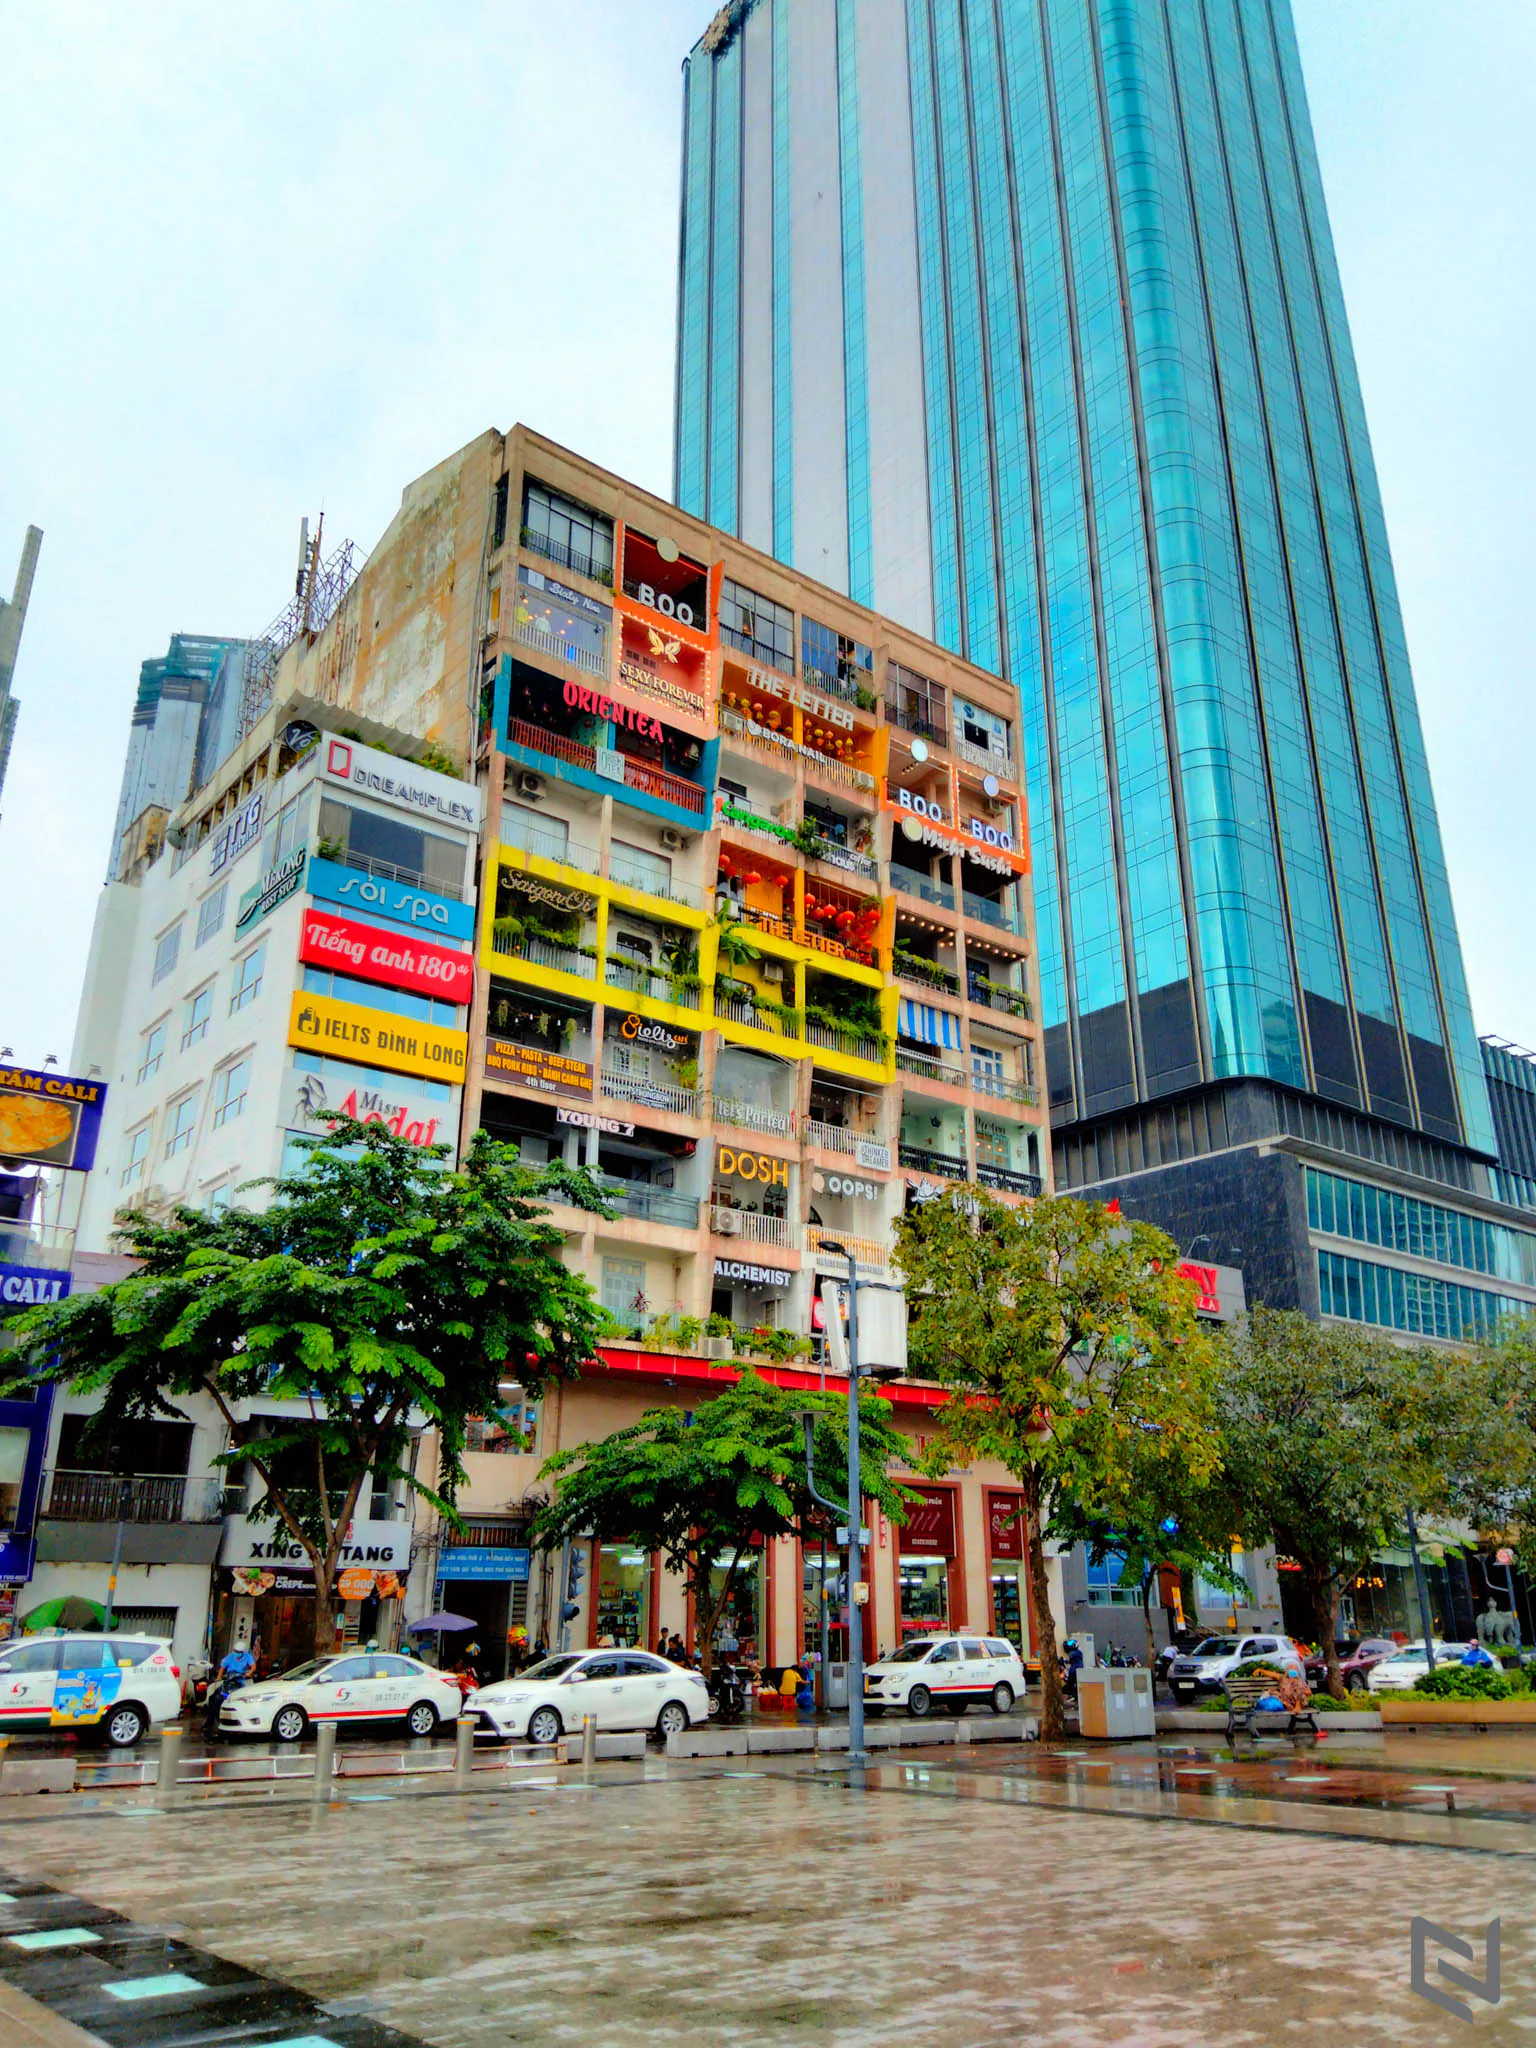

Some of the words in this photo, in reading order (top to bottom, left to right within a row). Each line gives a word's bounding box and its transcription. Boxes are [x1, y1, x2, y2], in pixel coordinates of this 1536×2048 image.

[638, 582, 694, 626] BOO
[621, 663, 651, 684] SEXY
[653, 676, 704, 709] FOREVER
[748, 665, 784, 698] THE
[788, 684, 854, 731] LETTER
[563, 681, 664, 743] ORIENTEA
[763, 728, 796, 751] BORA
[798, 744, 827, 764] NAIL
[353, 766, 475, 823] DREAMPLEX
[899, 787, 942, 823] BOO
[971, 818, 1013, 851] BOO
[969, 845, 1012, 877] Sushi
[306, 923, 365, 964] Tiếng
[370, 946, 414, 973] anh
[760, 917, 790, 940] THE
[792, 926, 846, 960] LETTER
[324, 1018, 371, 1045] IELTS
[377, 1027, 418, 1057] ĐÌNH
[423, 1041, 464, 1067] LONG
[495, 1041, 516, 1057] PIZZA
[521, 1048, 543, 1063] PASTA
[548, 1055, 565, 1068] BEEF
[565, 1059, 587, 1074] STEAK
[502, 1058, 521, 1073] PORK
[45, 1080, 98, 1102] CALI
[525, 1076, 538, 1088] 4th
[540, 1079, 556, 1091] floor
[359, 1090, 401, 1115] Miss
[557, 1107, 621, 1134] YOUNG
[623, 1119, 635, 1137] 7
[720, 1147, 789, 1188] DOSH
[828, 1176, 879, 1200] OOPS!
[713, 1260, 792, 1287] ALCHEMIST
[3, 1277, 62, 1304] CALI
[250, 1542, 303, 1559] XING
[341, 1546, 394, 1561] TANG
[275, 1579, 303, 1589] CREPE
